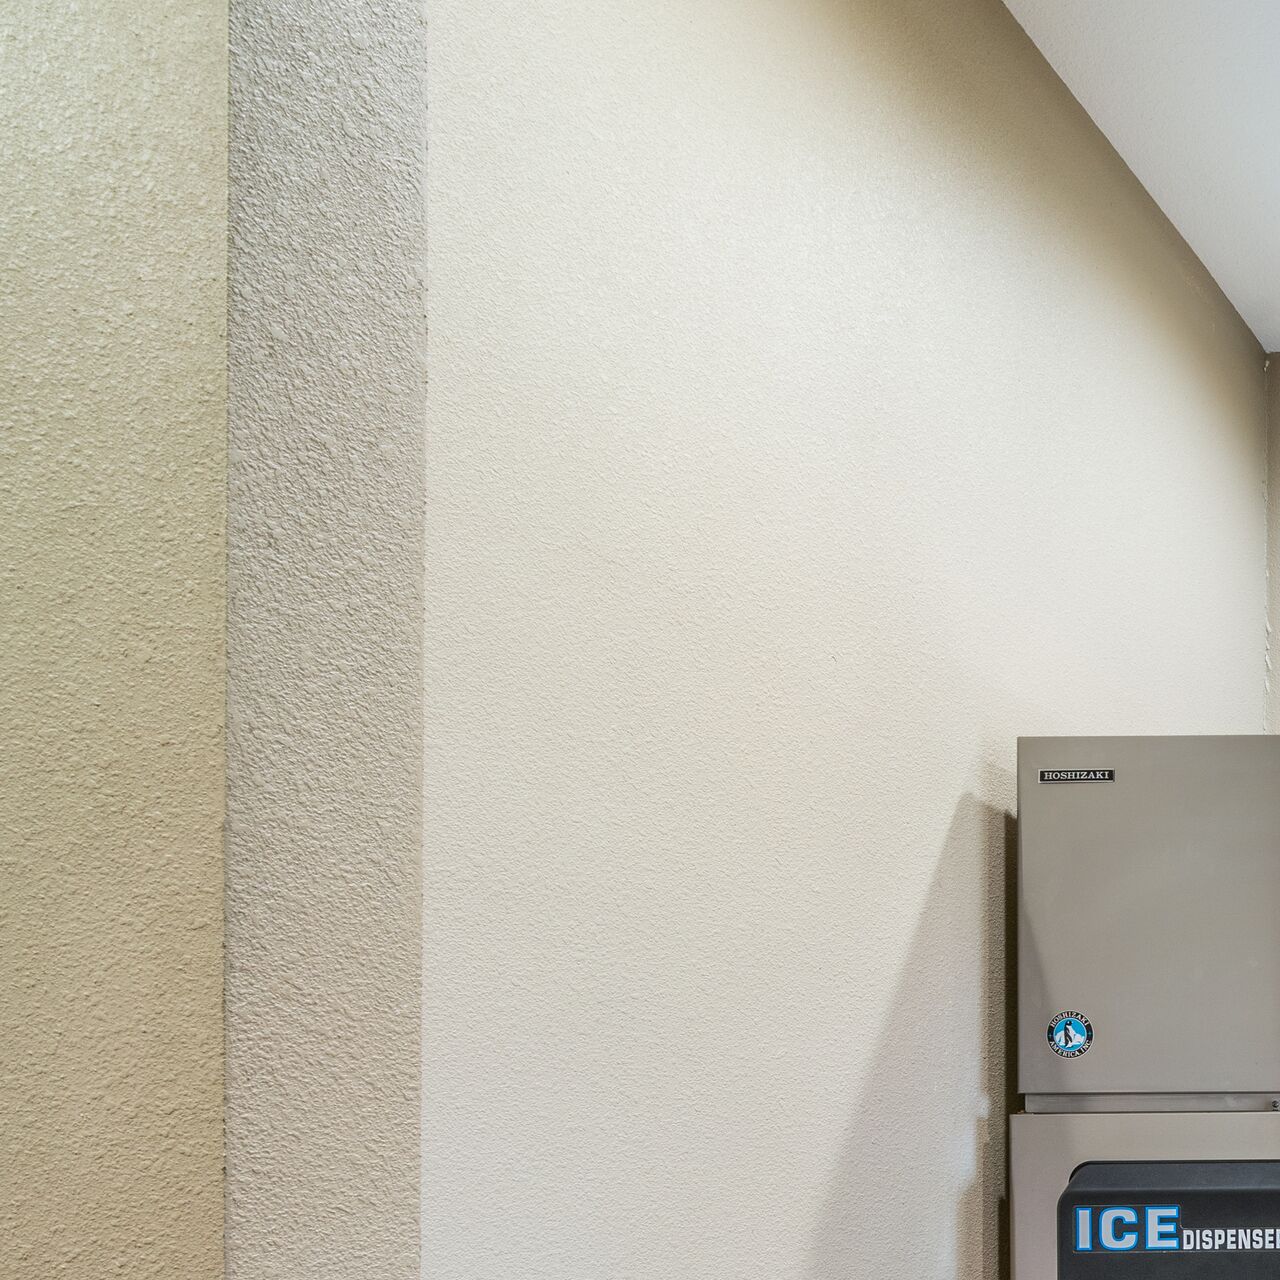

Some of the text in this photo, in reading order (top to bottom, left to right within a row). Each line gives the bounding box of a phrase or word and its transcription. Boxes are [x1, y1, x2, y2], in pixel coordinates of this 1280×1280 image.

[1043, 771, 1110, 780] HOSHIZAKI
[1049, 1011, 1090, 1028] HOSHIZAKI
[1075, 1205, 1180, 1251] ICE
